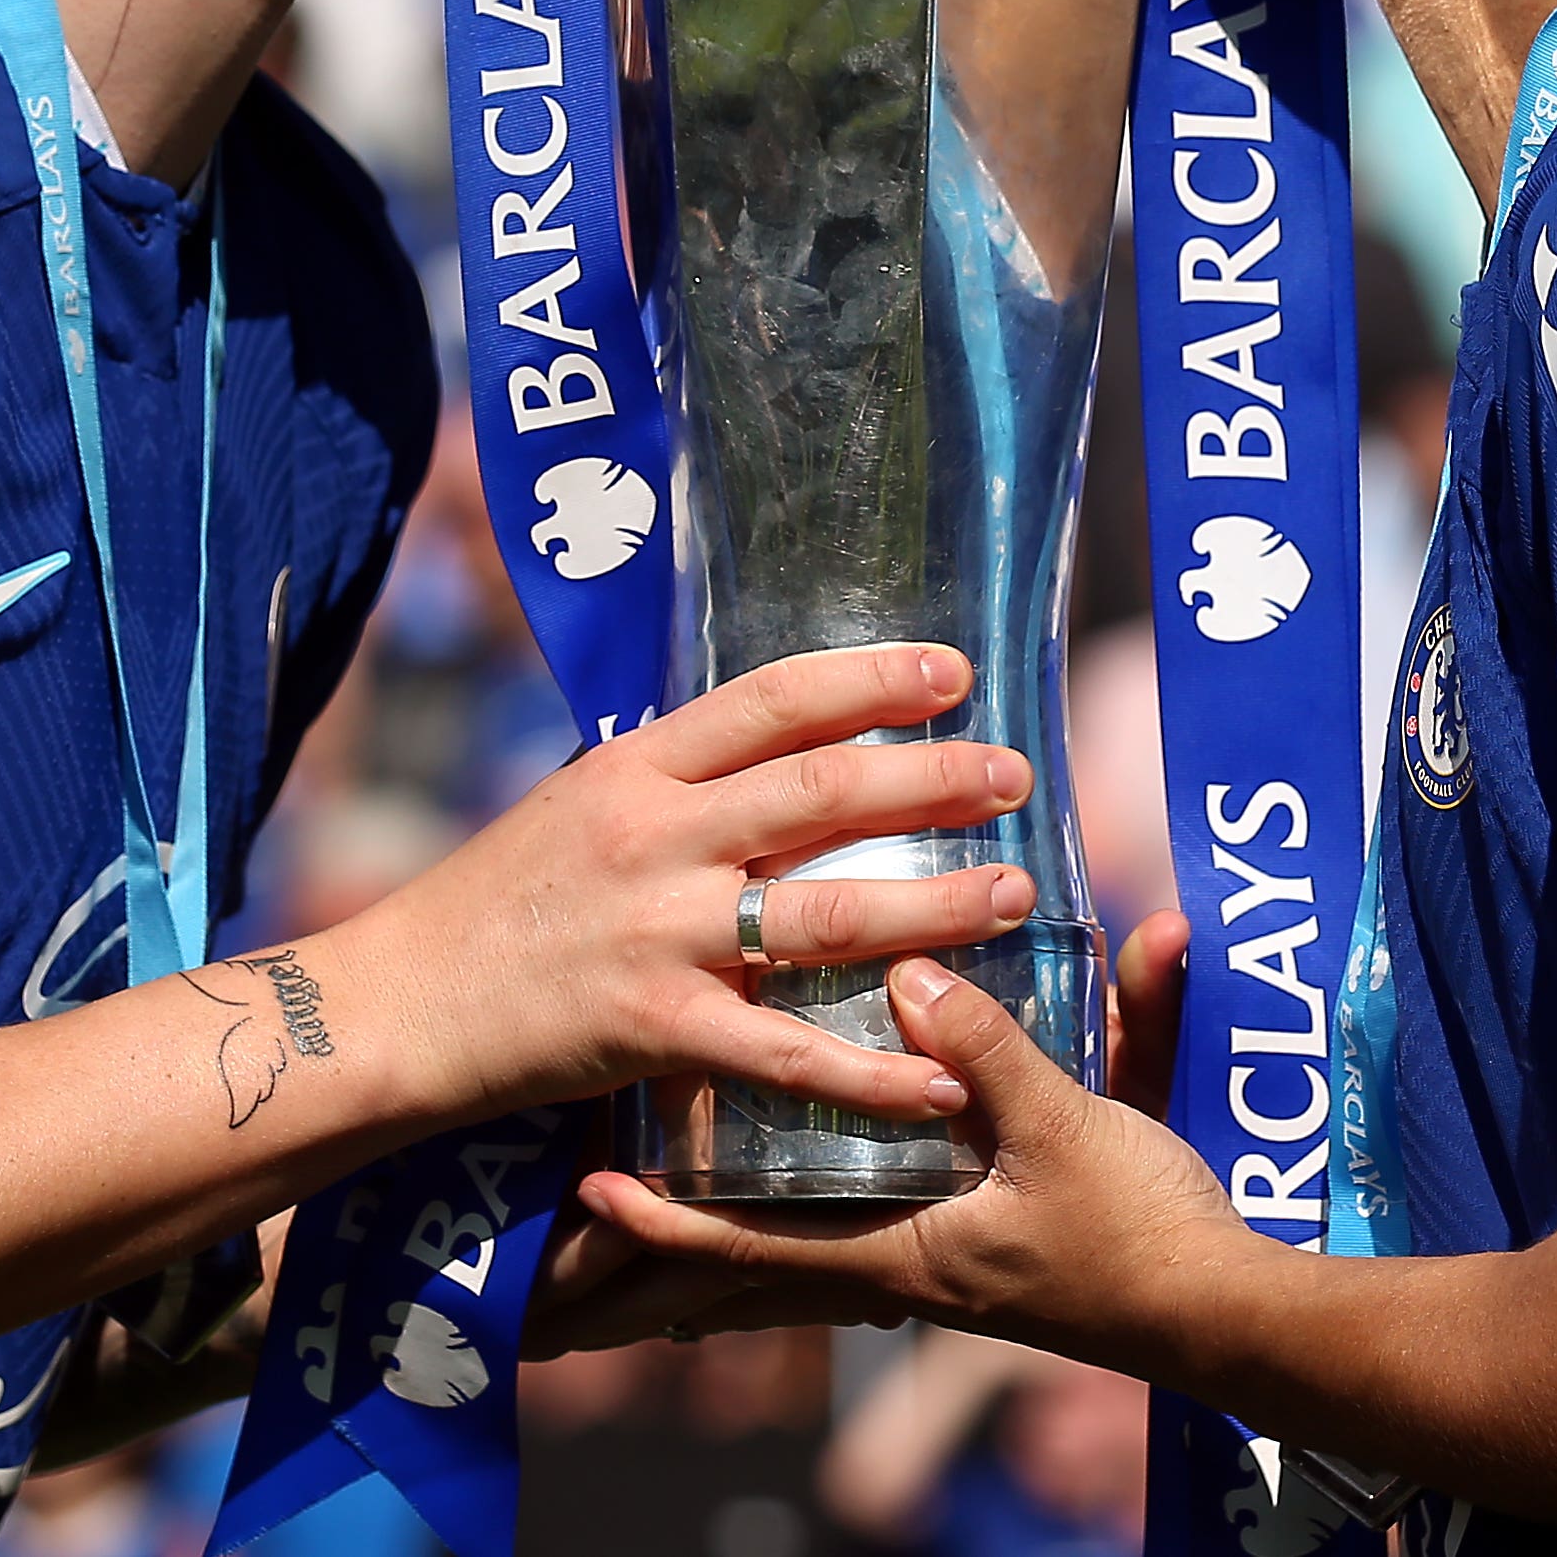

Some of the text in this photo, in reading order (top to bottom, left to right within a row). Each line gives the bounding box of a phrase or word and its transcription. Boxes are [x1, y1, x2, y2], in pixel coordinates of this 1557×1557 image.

[27, 95, 81, 316] BARCLAYS
[1425, 610, 1452, 650] CHE
[1413, 759, 1454, 798] FOOTBALL
[1205, 780, 1331, 1254] RCLAYS
[1339, 999, 1390, 1219] BARCLAYS
